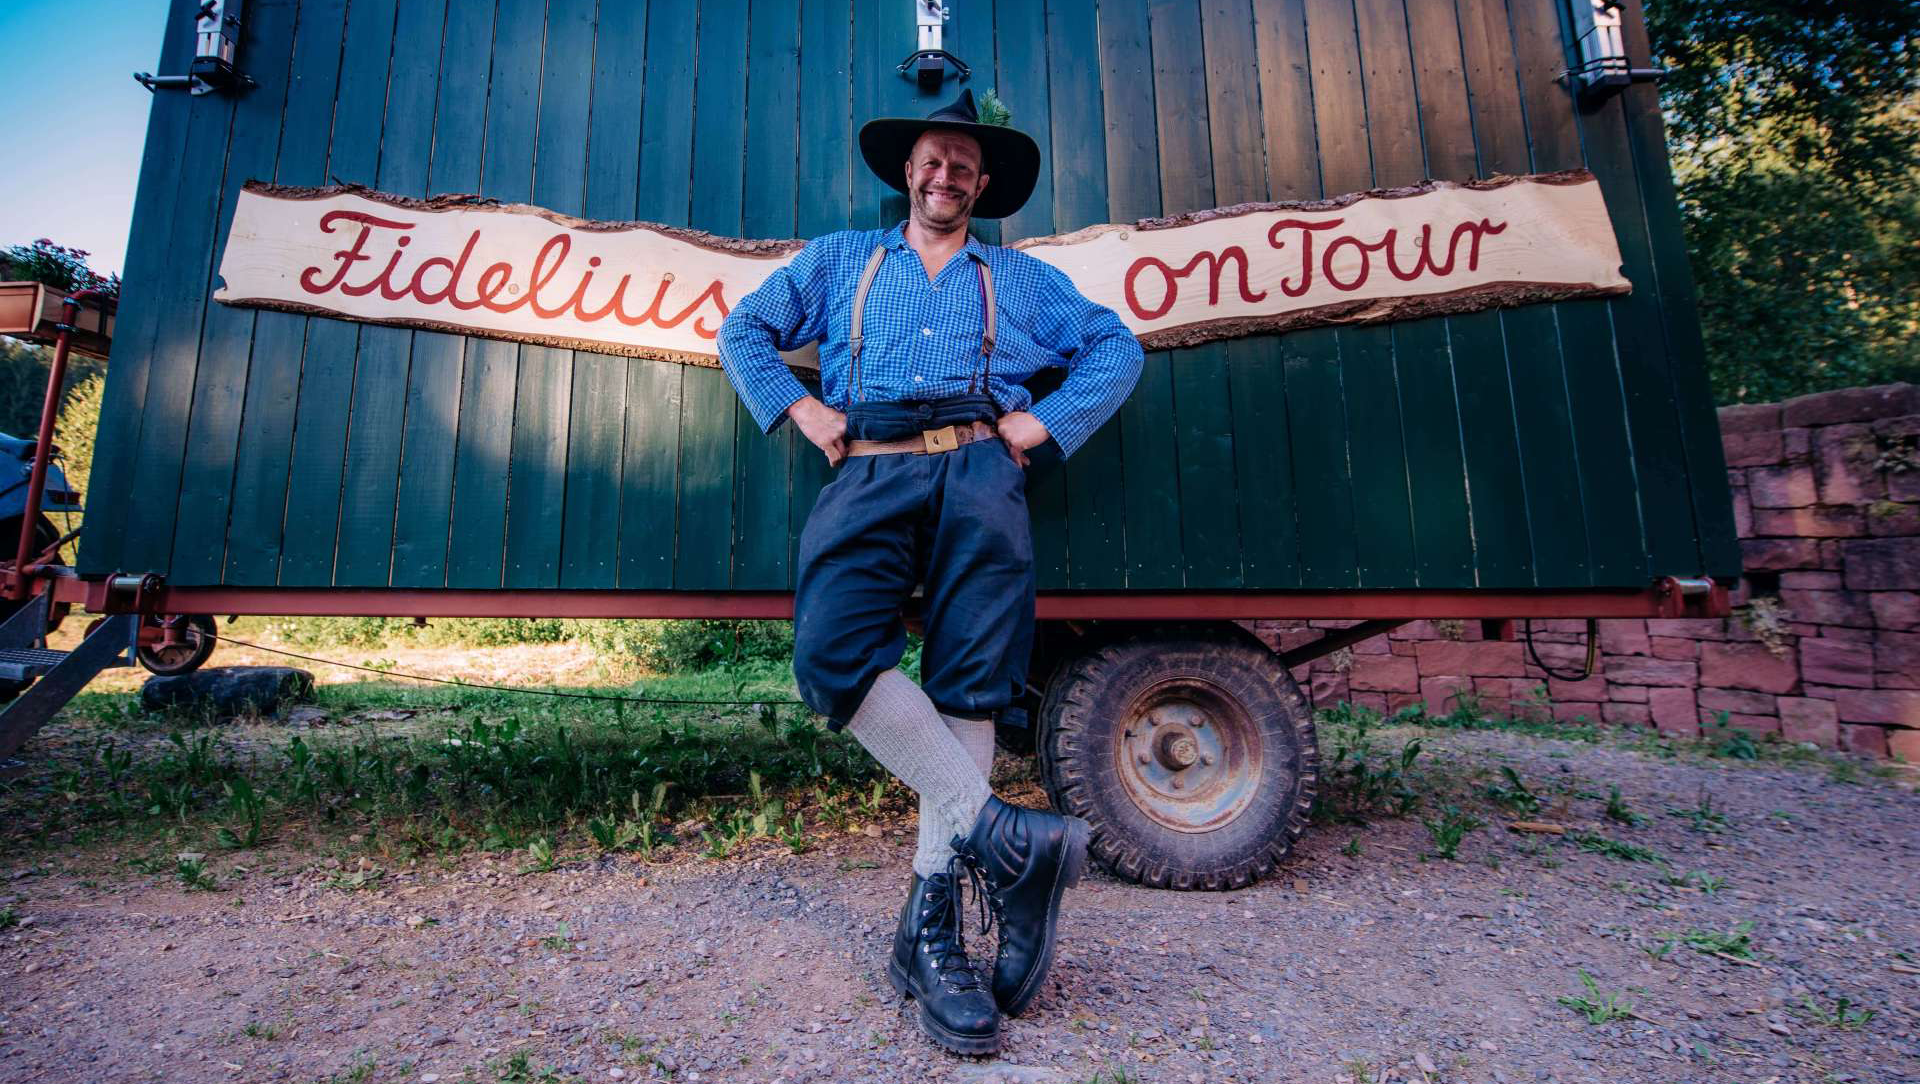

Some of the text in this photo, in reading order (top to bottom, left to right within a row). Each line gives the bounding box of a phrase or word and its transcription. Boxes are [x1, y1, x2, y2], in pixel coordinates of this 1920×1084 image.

[300, 210, 1507, 339] Fidelius on Tour
